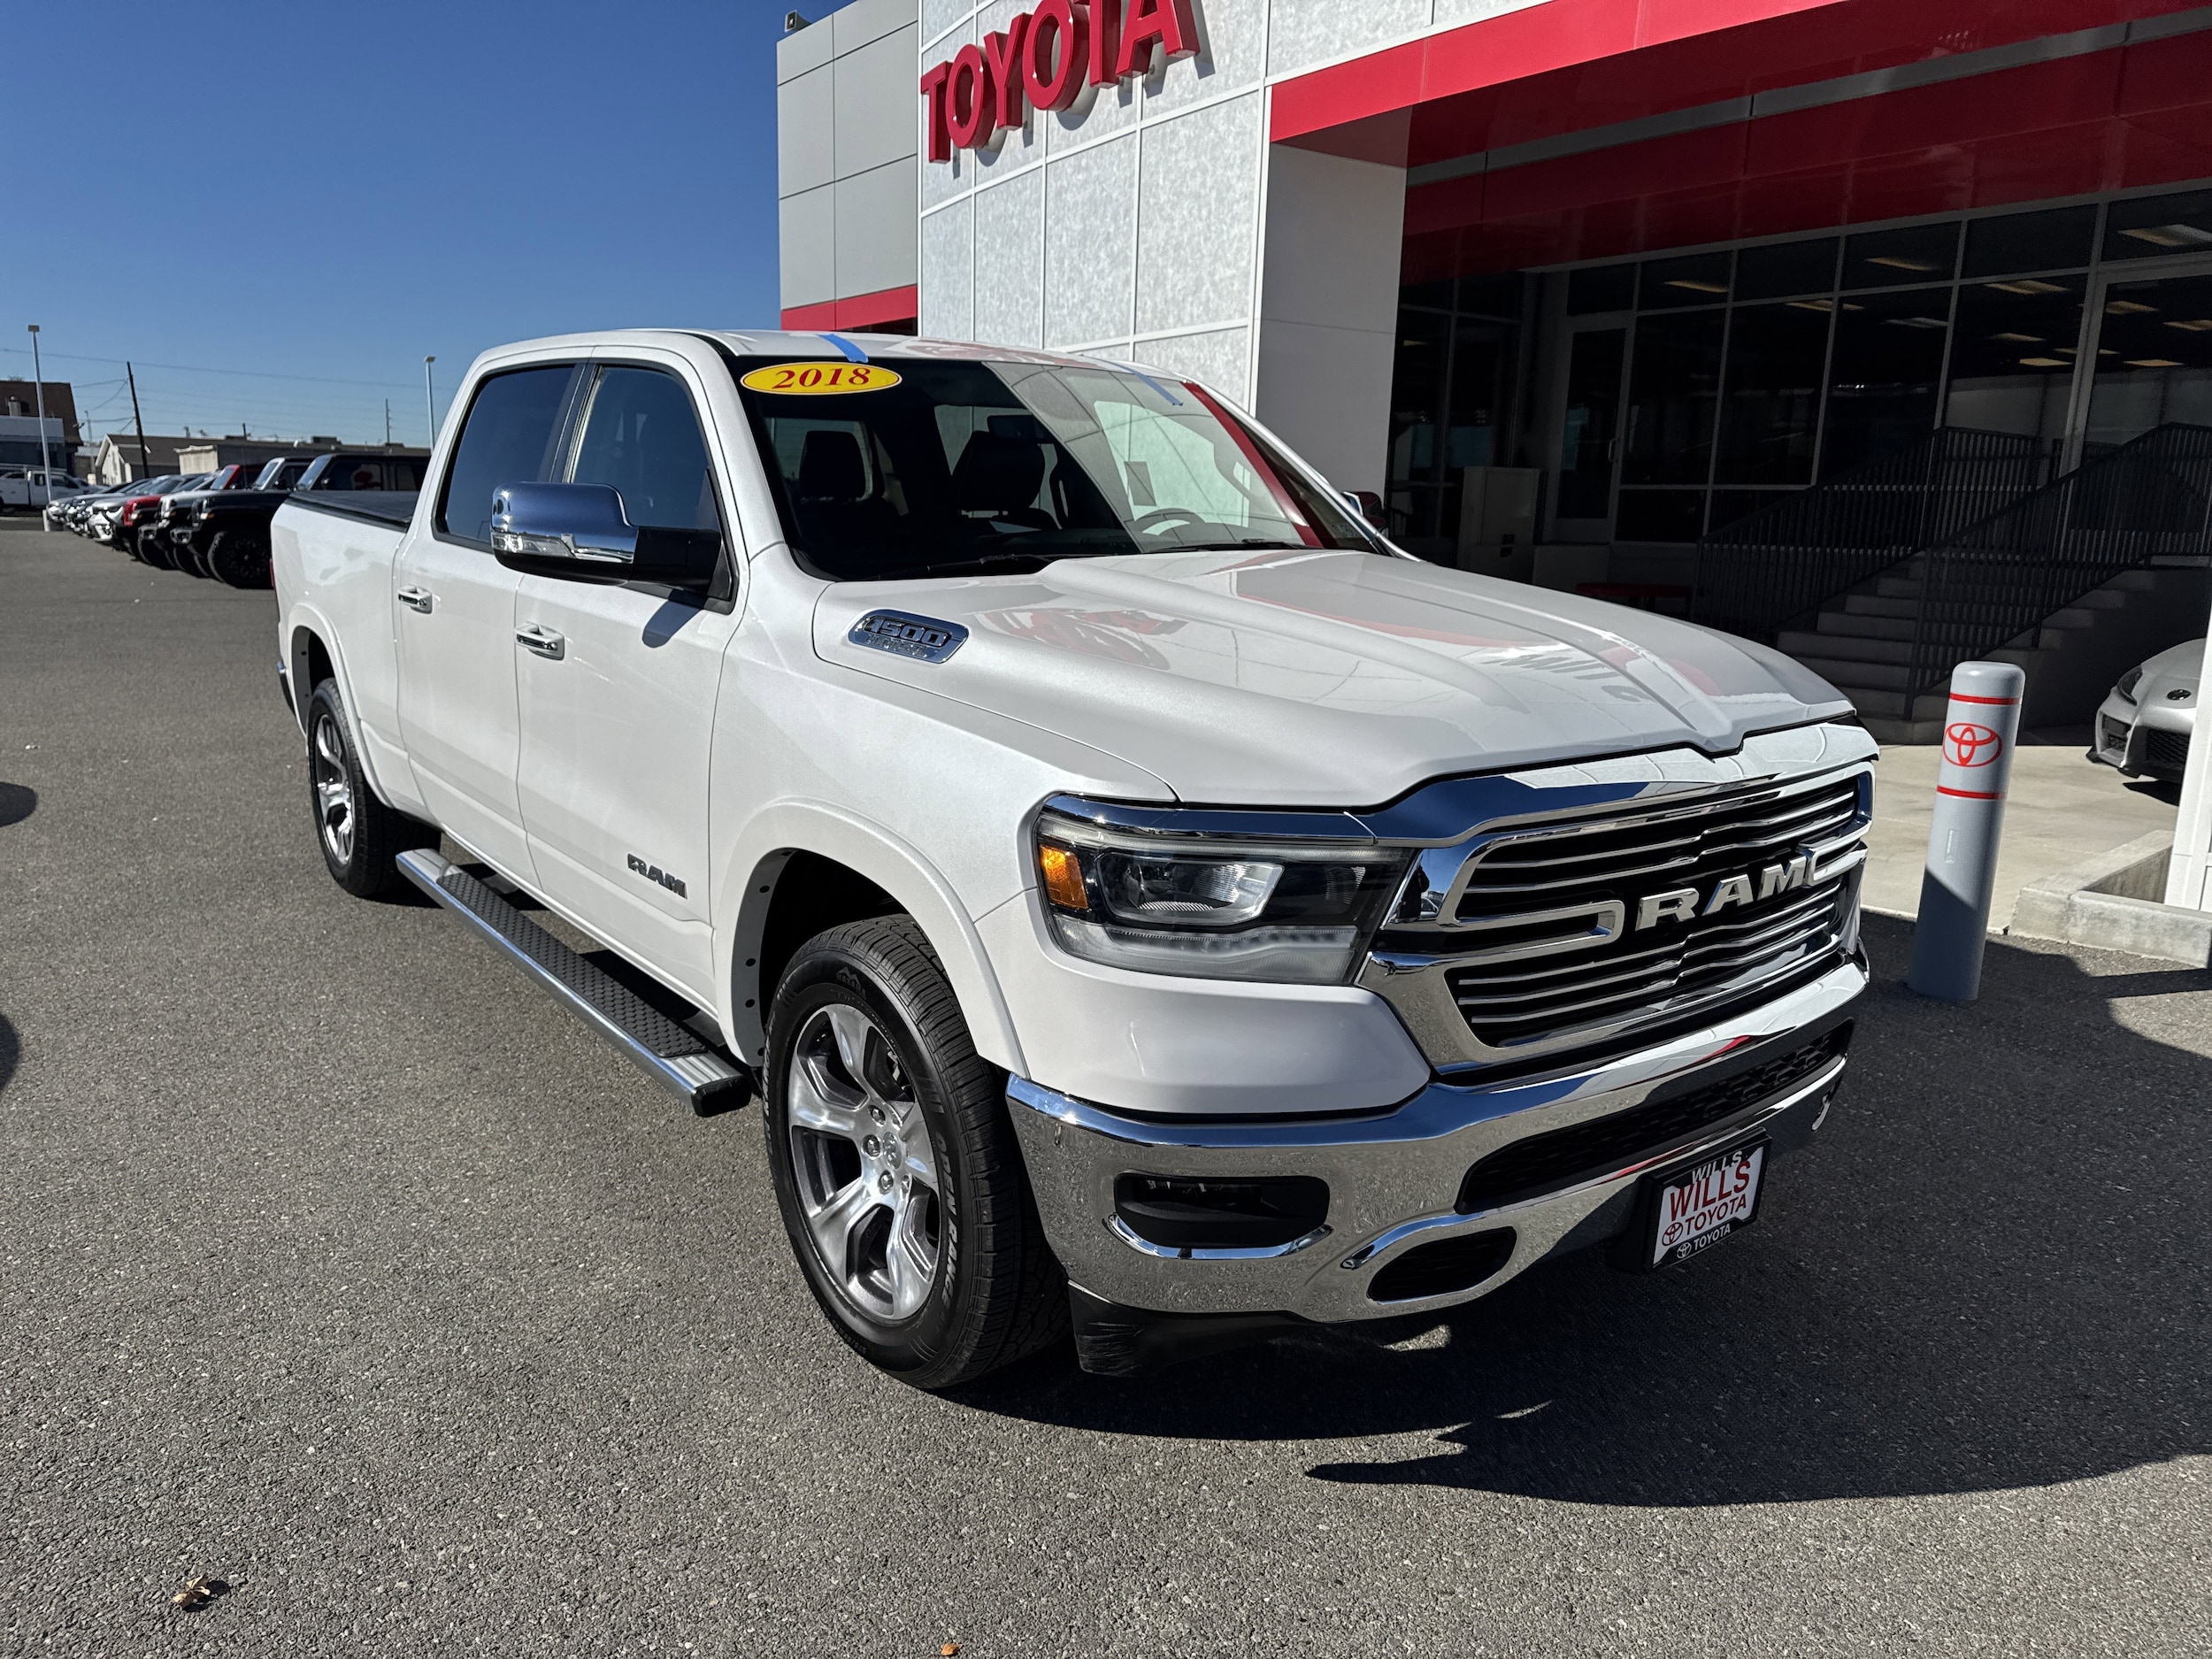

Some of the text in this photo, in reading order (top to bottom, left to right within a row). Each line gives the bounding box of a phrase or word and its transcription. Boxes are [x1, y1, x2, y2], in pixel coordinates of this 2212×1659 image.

[920, 0, 1200, 165] TOYOTA
[772, 367, 871, 389] 2018
[869, 618, 948, 648] 1500
[627, 853, 687, 900] RAM
[1635, 856, 1807, 932] RAM
[936, 1133, 956, 1216] OPEN
[1692, 1150, 1742, 1184] WILLS
[1671, 1160, 1750, 1222] WILLS
[1686, 1194, 1747, 1236] TOYOTA
[1694, 1223, 1731, 1250] TOYOTA
[941, 1216, 957, 1310] RANGE
